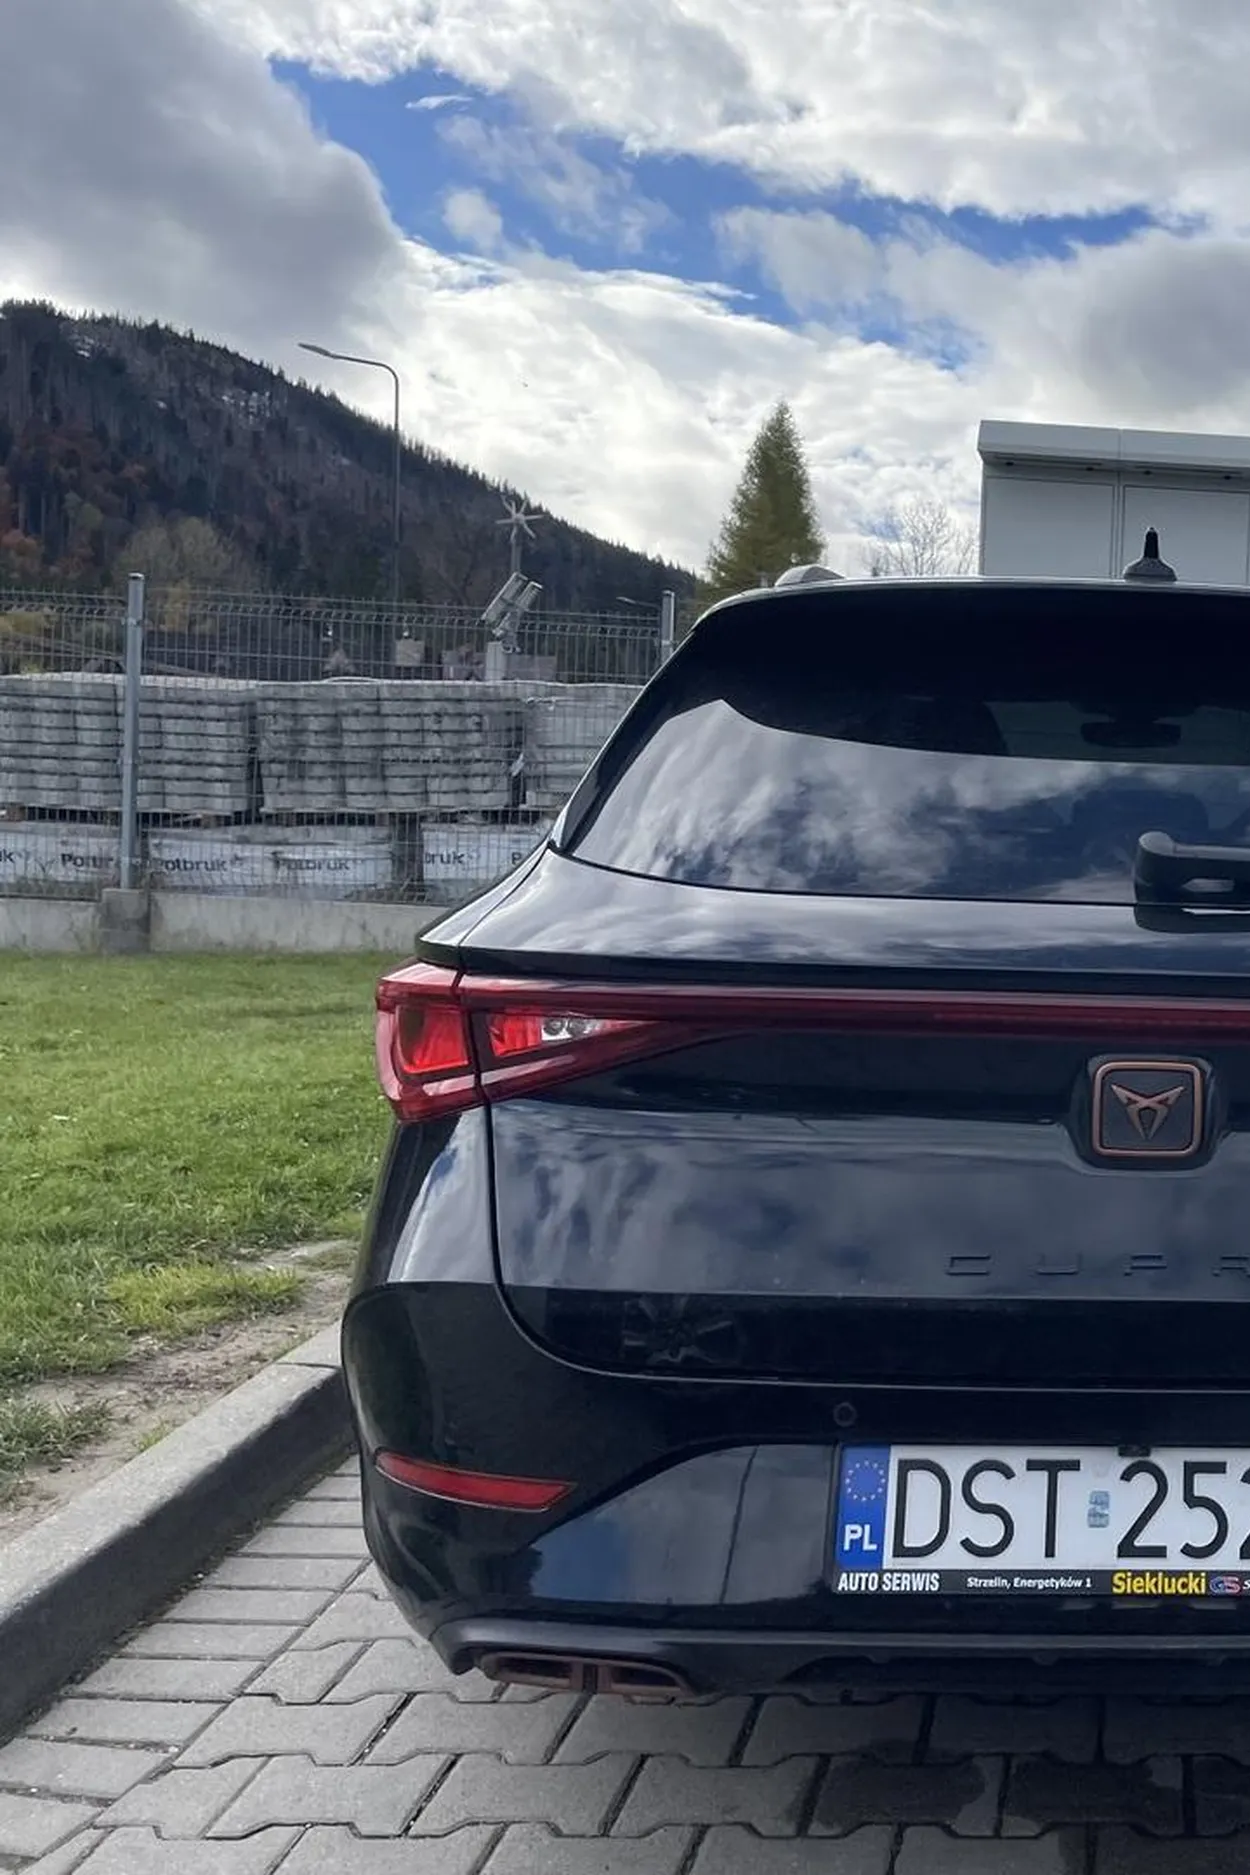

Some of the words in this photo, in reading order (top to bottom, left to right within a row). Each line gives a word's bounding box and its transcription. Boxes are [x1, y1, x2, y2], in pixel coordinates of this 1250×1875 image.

[153, 857, 228, 872] olbruk
[892, 1457, 1082, 1559] DST
[843, 1523, 878, 1551] PL
[838, 1572, 879, 1592] AUTO
[882, 1572, 941, 1593] SERWIS
[1085, 1577, 1092, 1588] 1
[1112, 1572, 1207, 1595] Sieklucki
